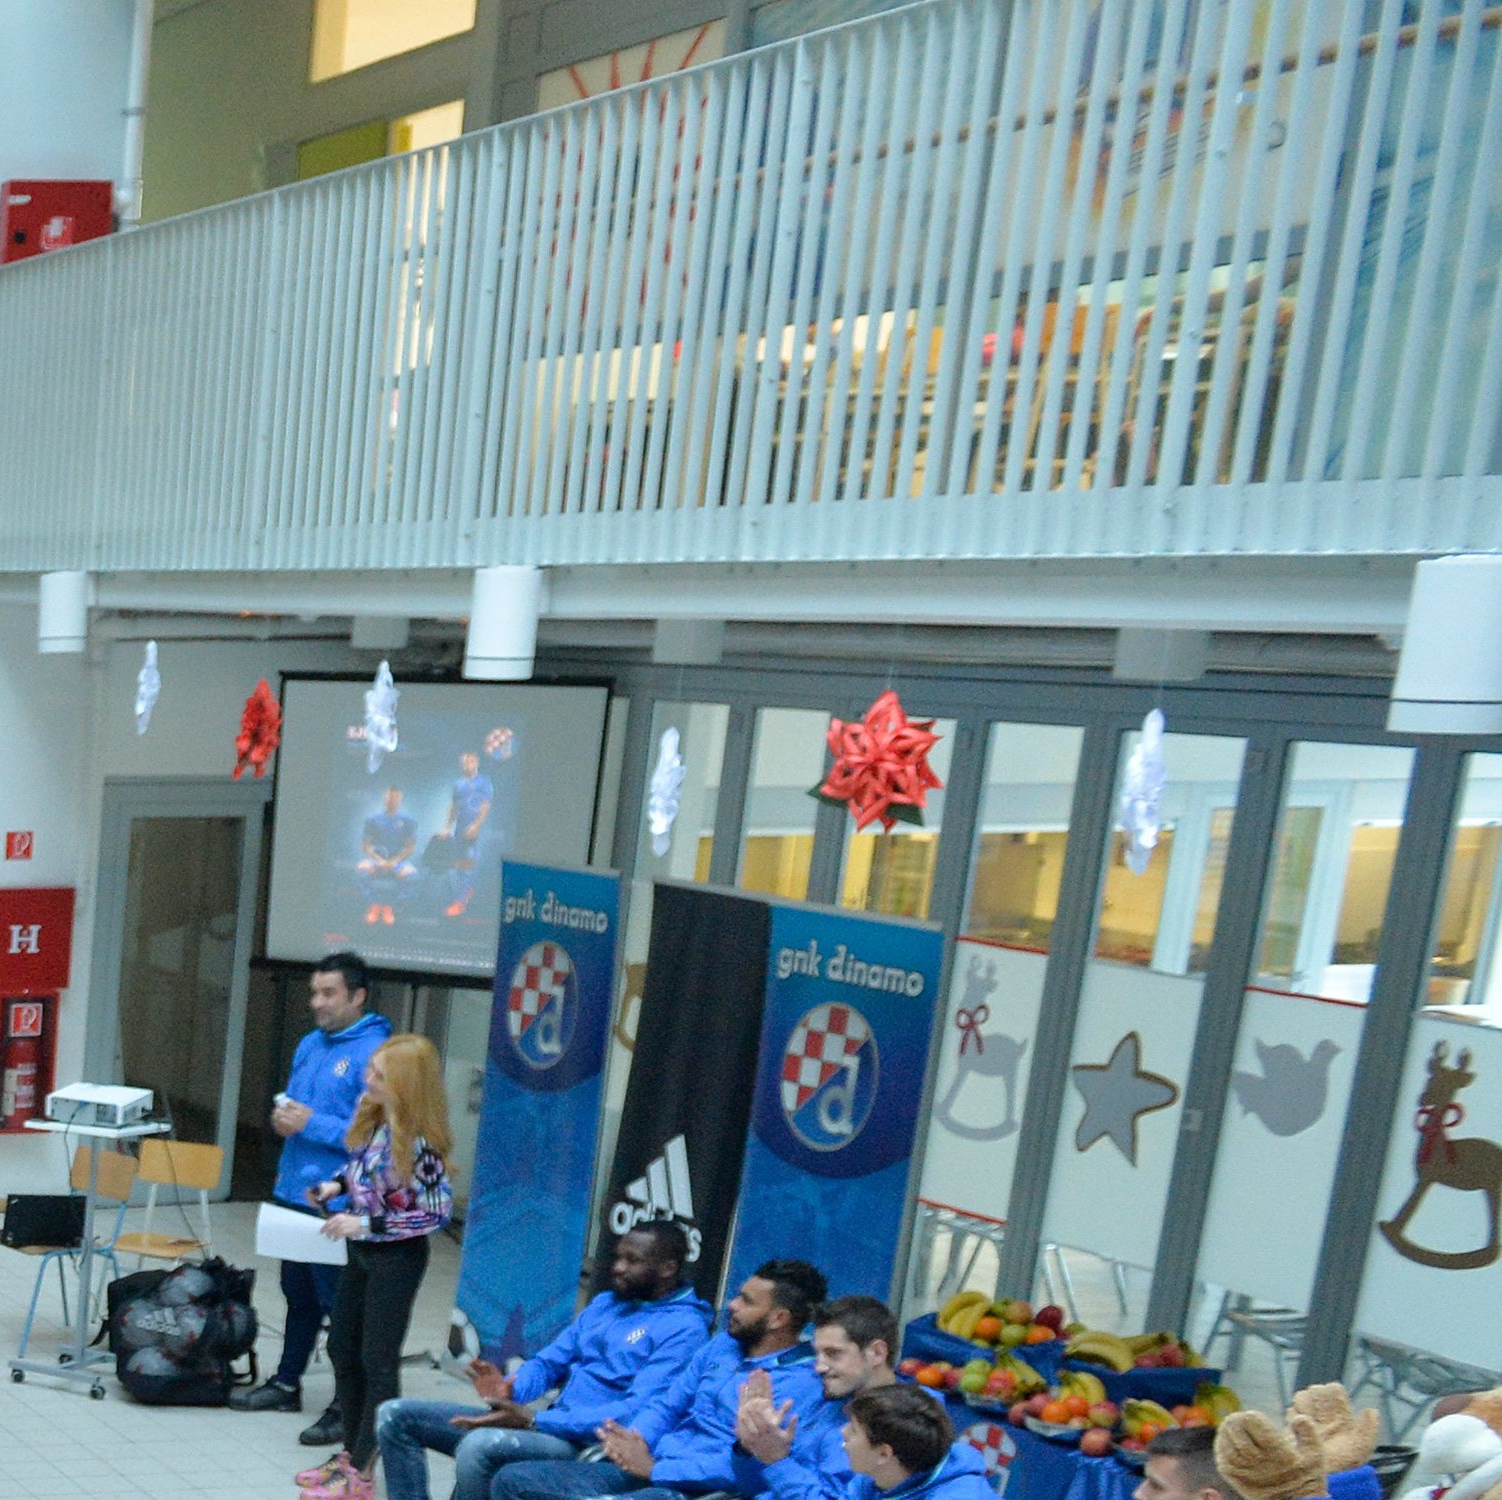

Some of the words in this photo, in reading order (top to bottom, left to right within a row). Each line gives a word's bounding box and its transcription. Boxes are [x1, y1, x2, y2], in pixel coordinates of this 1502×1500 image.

[504, 888, 536, 924] gnk
[540, 891, 609, 935] dinamo
[8, 924, 42, 954] H
[777, 939, 822, 979] gnk
[826, 944, 925, 997] dinamo
[610, 1199, 703, 1263] ads
